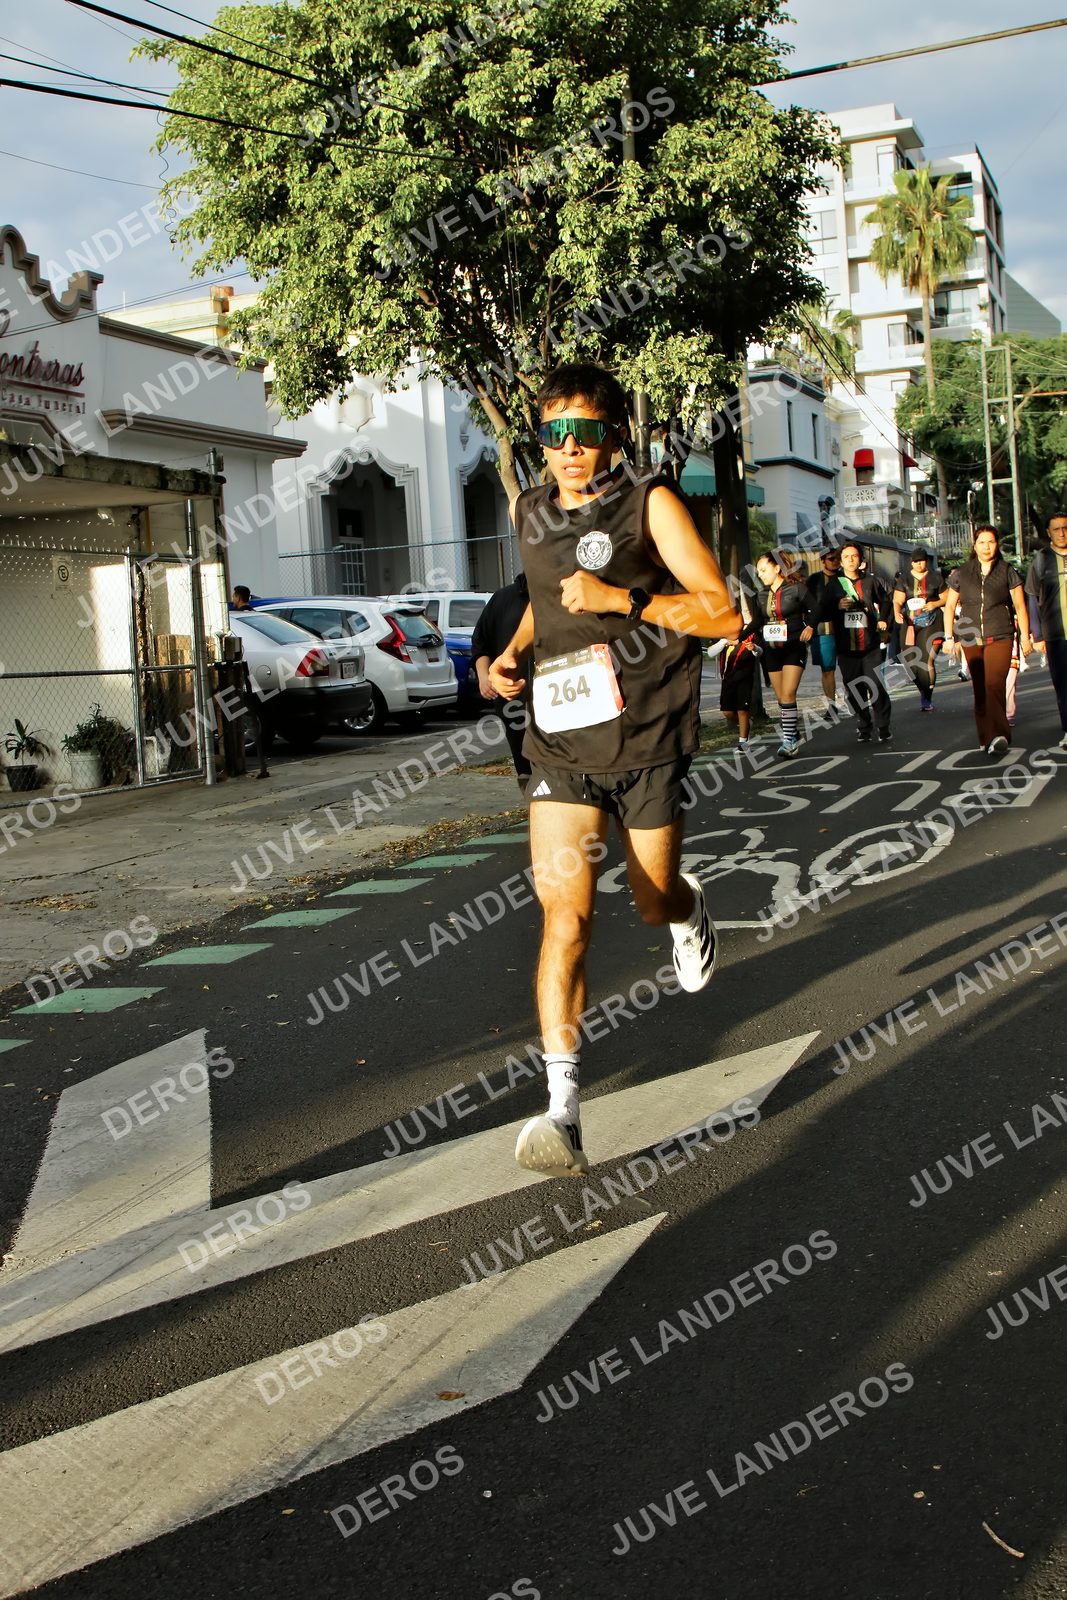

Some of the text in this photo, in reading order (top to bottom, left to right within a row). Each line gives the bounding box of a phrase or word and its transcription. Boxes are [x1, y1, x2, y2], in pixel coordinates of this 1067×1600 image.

[0, 340, 85, 386] ontreras
[847, 613, 863, 622] 7037
[548, 675, 591, 707] 264
[719, 774, 1056, 817] BUS
